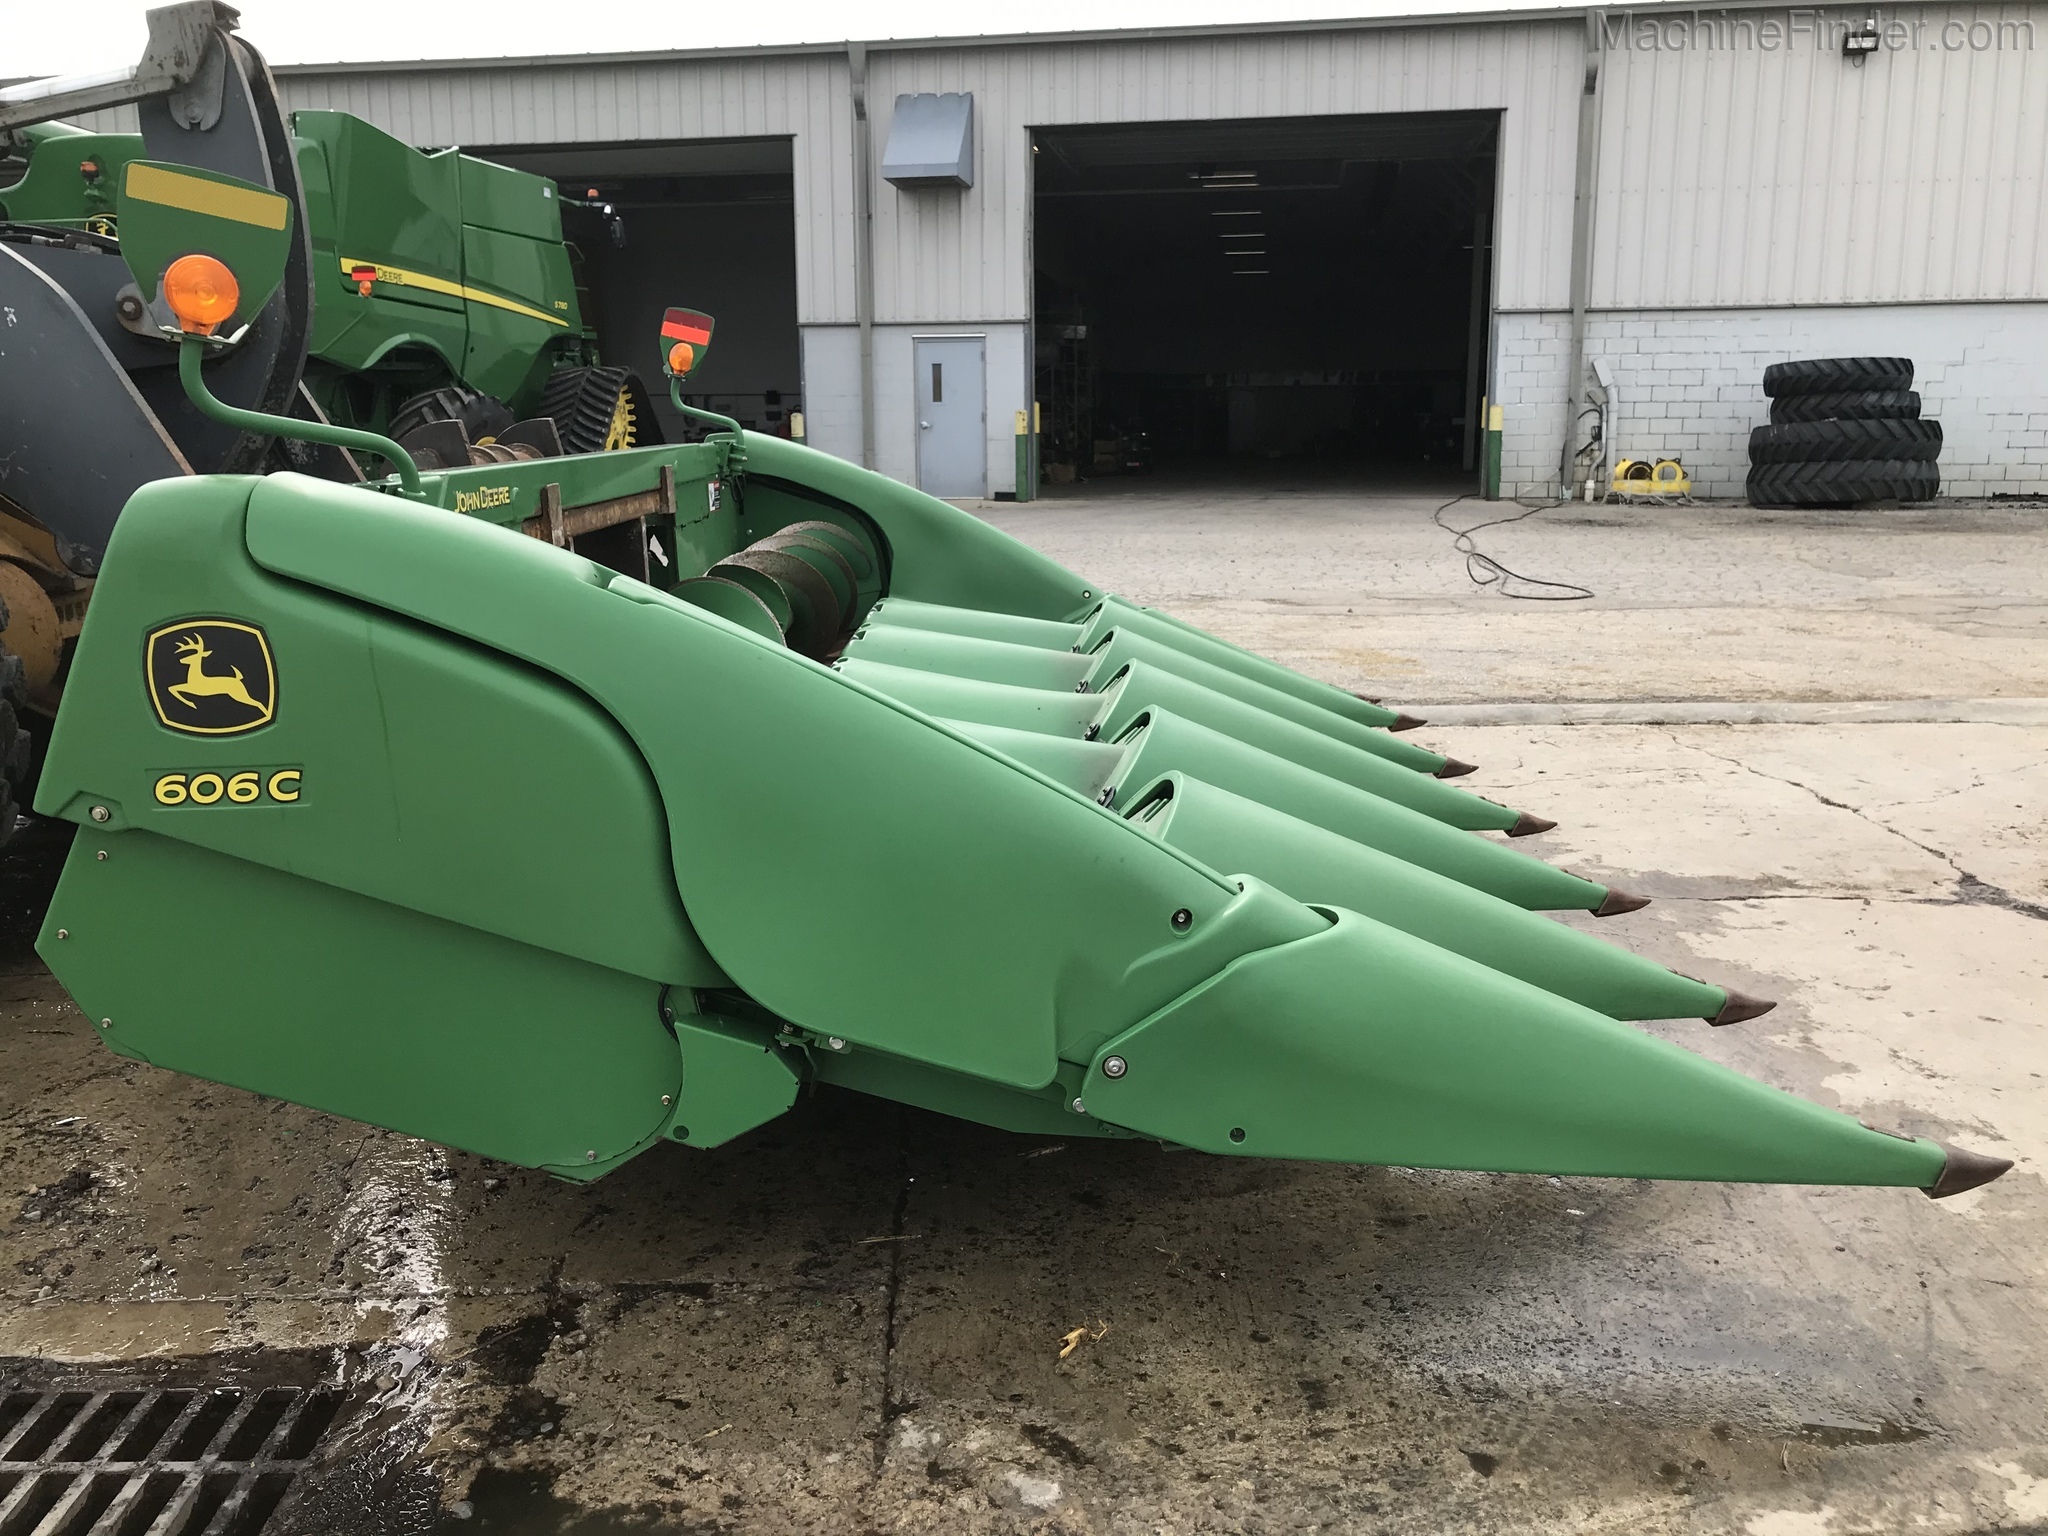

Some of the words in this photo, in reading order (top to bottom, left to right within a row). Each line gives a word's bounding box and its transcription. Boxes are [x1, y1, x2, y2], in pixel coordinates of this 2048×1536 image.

[377, 267, 403, 283] DEERE
[454, 490, 480, 513] JOHN
[480, 486, 511, 508] DEERE
